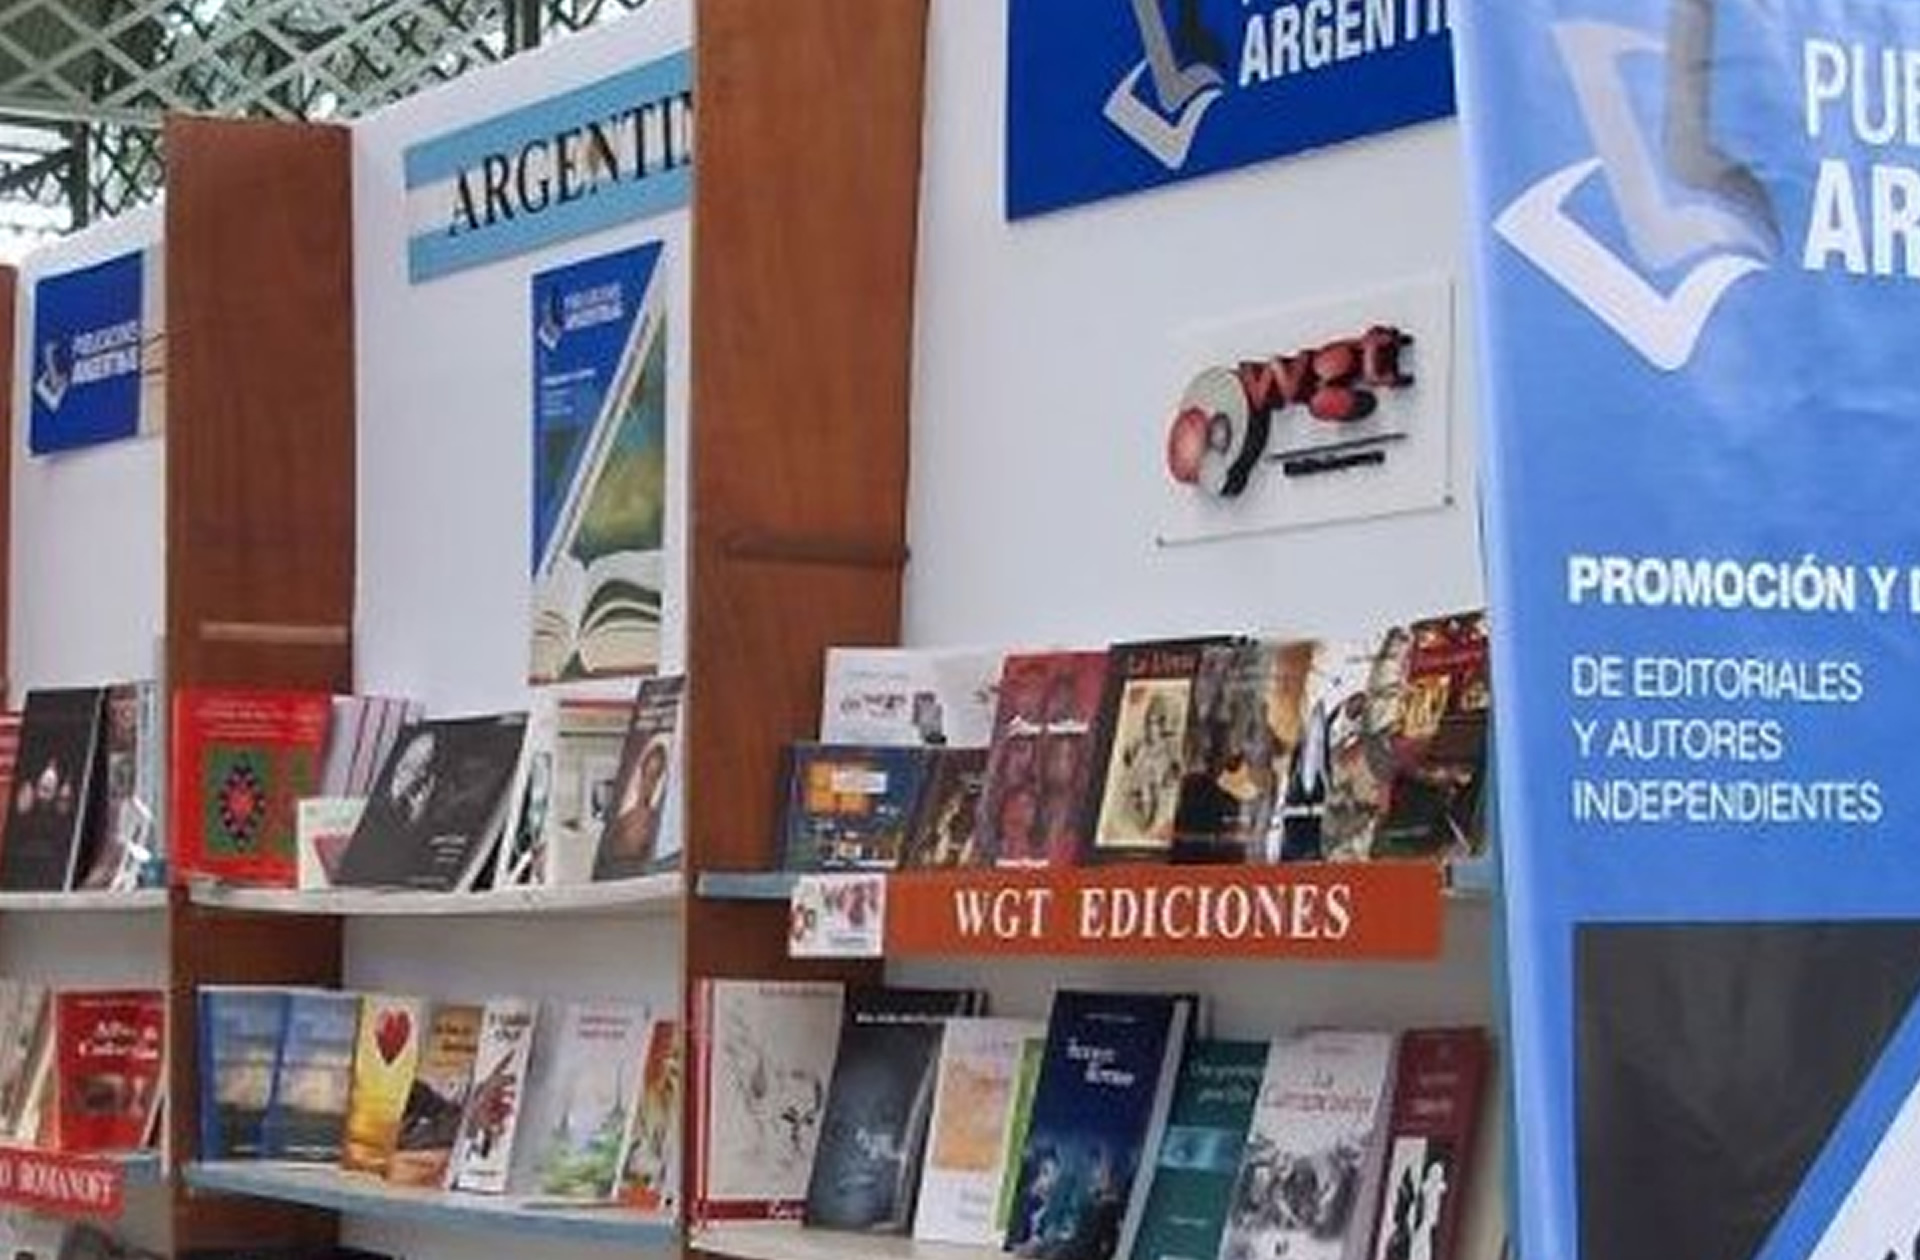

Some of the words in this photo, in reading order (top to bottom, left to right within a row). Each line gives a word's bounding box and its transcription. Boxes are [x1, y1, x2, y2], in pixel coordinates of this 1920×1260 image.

[1238, 0, 1453, 87] ARGENT
[1568, 553, 1856, 612] PROMOCIÓN
[1868, 566, 1898, 612] Y
[1572, 655, 1624, 698] DE
[1633, 657, 1864, 702] EDITORIALES
[1571, 718, 1598, 758] Y
[1607, 718, 1784, 762] AUTORES
[1573, 780, 1884, 822] INDEPENDIENTES
[954, 888, 1050, 940] WGT
[1079, 884, 1352, 940] EDICIONES
